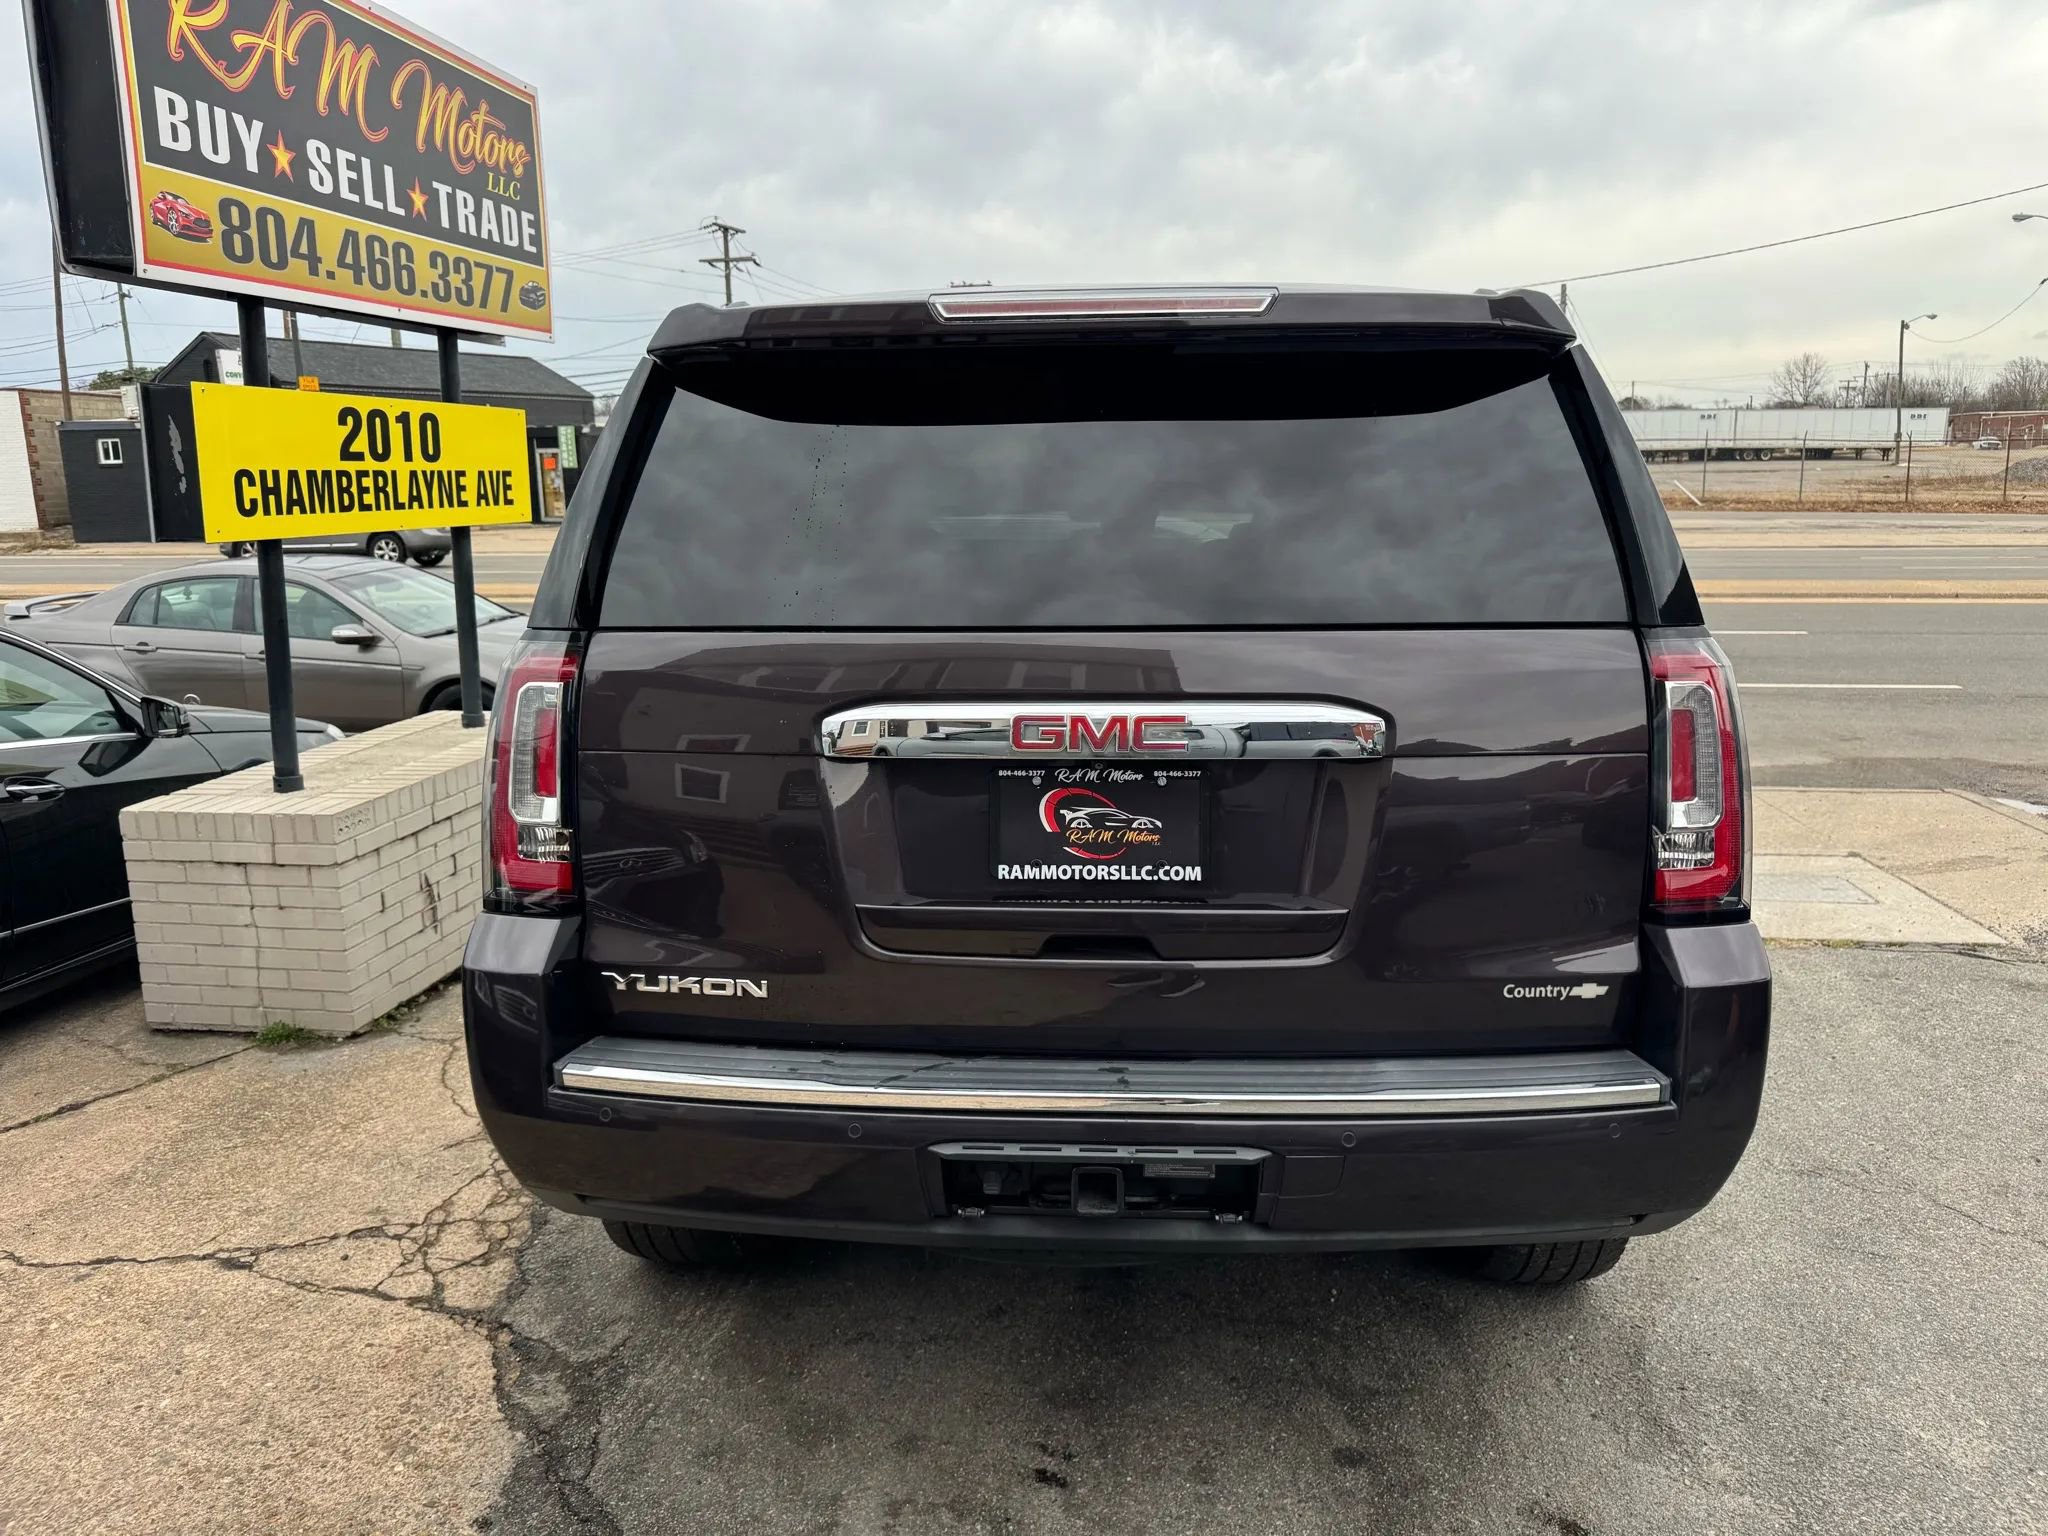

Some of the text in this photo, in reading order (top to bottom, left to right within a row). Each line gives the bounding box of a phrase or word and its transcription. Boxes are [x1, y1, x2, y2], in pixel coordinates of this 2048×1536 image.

[167, 0, 532, 178] RAM Motors
[153, 86, 538, 254] BUY SELL TRADE
[487, 172, 521, 200] LLC
[219, 197, 515, 314] 804.466.3377
[337, 407, 442, 463] 2010
[233, 468, 514, 518] CHAMBERLAYNE AVE
[1010, 713, 1189, 753] GMC
[998, 768, 1202, 783] 804-466-3377 RAM Motors 804-466-3377
[1066, 828, 1161, 844] RAM Motors
[998, 864, 1202, 882] RAMMOTORSLLC.COM
[601, 971, 769, 999] YUKON
[1503, 983, 1571, 1001] Country
